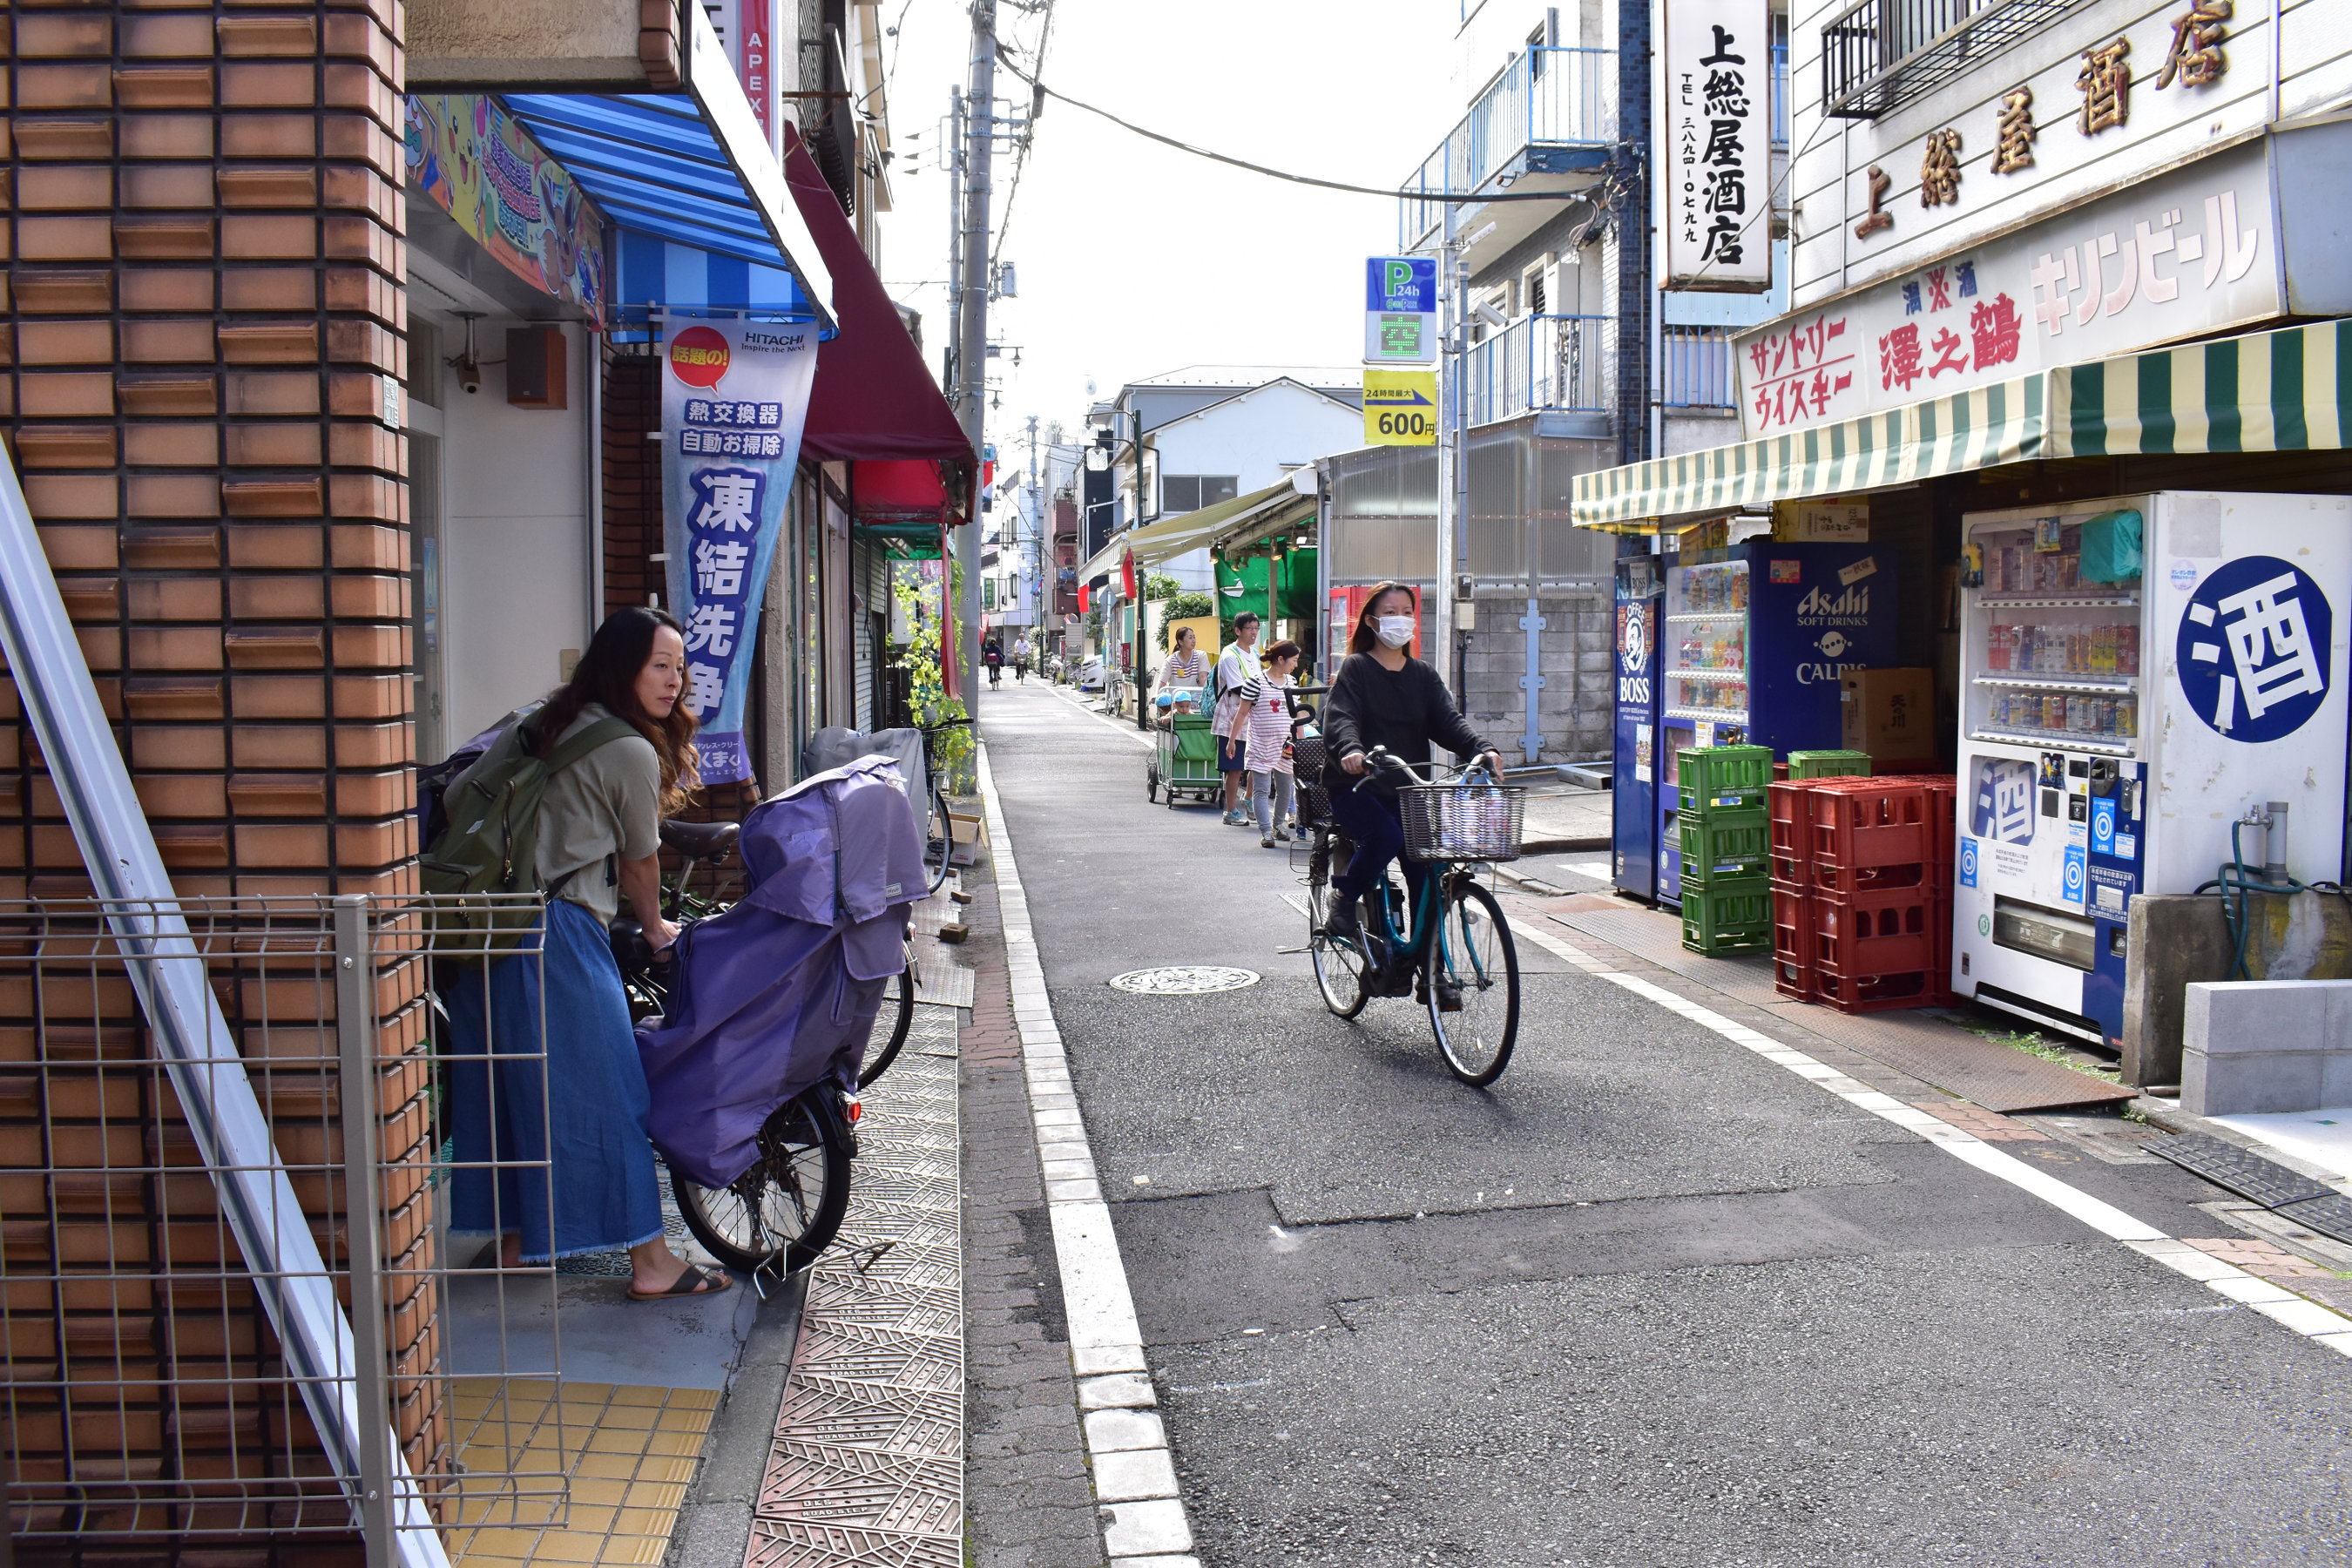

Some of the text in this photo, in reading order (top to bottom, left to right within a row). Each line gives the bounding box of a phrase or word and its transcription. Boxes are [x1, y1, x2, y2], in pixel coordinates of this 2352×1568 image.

[747, 32, 763, 112] APEX
[1681, 73, 1693, 106] TEL
[1699, 24, 1750, 265] 上総屋酒店
[1385, 260, 1413, 297] P
[2031, 190, 2257, 336] キリンビール
[1396, 285, 1420, 296] 24h
[741, 342, 769, 353] Inspire
[787, 343, 805, 353] Next
[745, 332, 805, 346] HITACHI
[1381, 316, 1420, 356] 空
[1750, 314, 1847, 381] サントリー
[672, 345, 728, 367] 話題の!
[688, 401, 778, 425] 熱交換器
[1754, 368, 1852, 431] ウイスキー
[1378, 412, 1435, 436] 600円
[682, 430, 781, 456] 自動お掃除
[1632, 577, 1646, 589] BOSS
[1797, 585, 1869, 616] Asahi
[1797, 617, 1869, 626] SOFT DRINKS
[2189, 571, 2324, 730] 酒
[1619, 677, 1650, 704] BOSS
[1979, 759, 2033, 842] 酒
